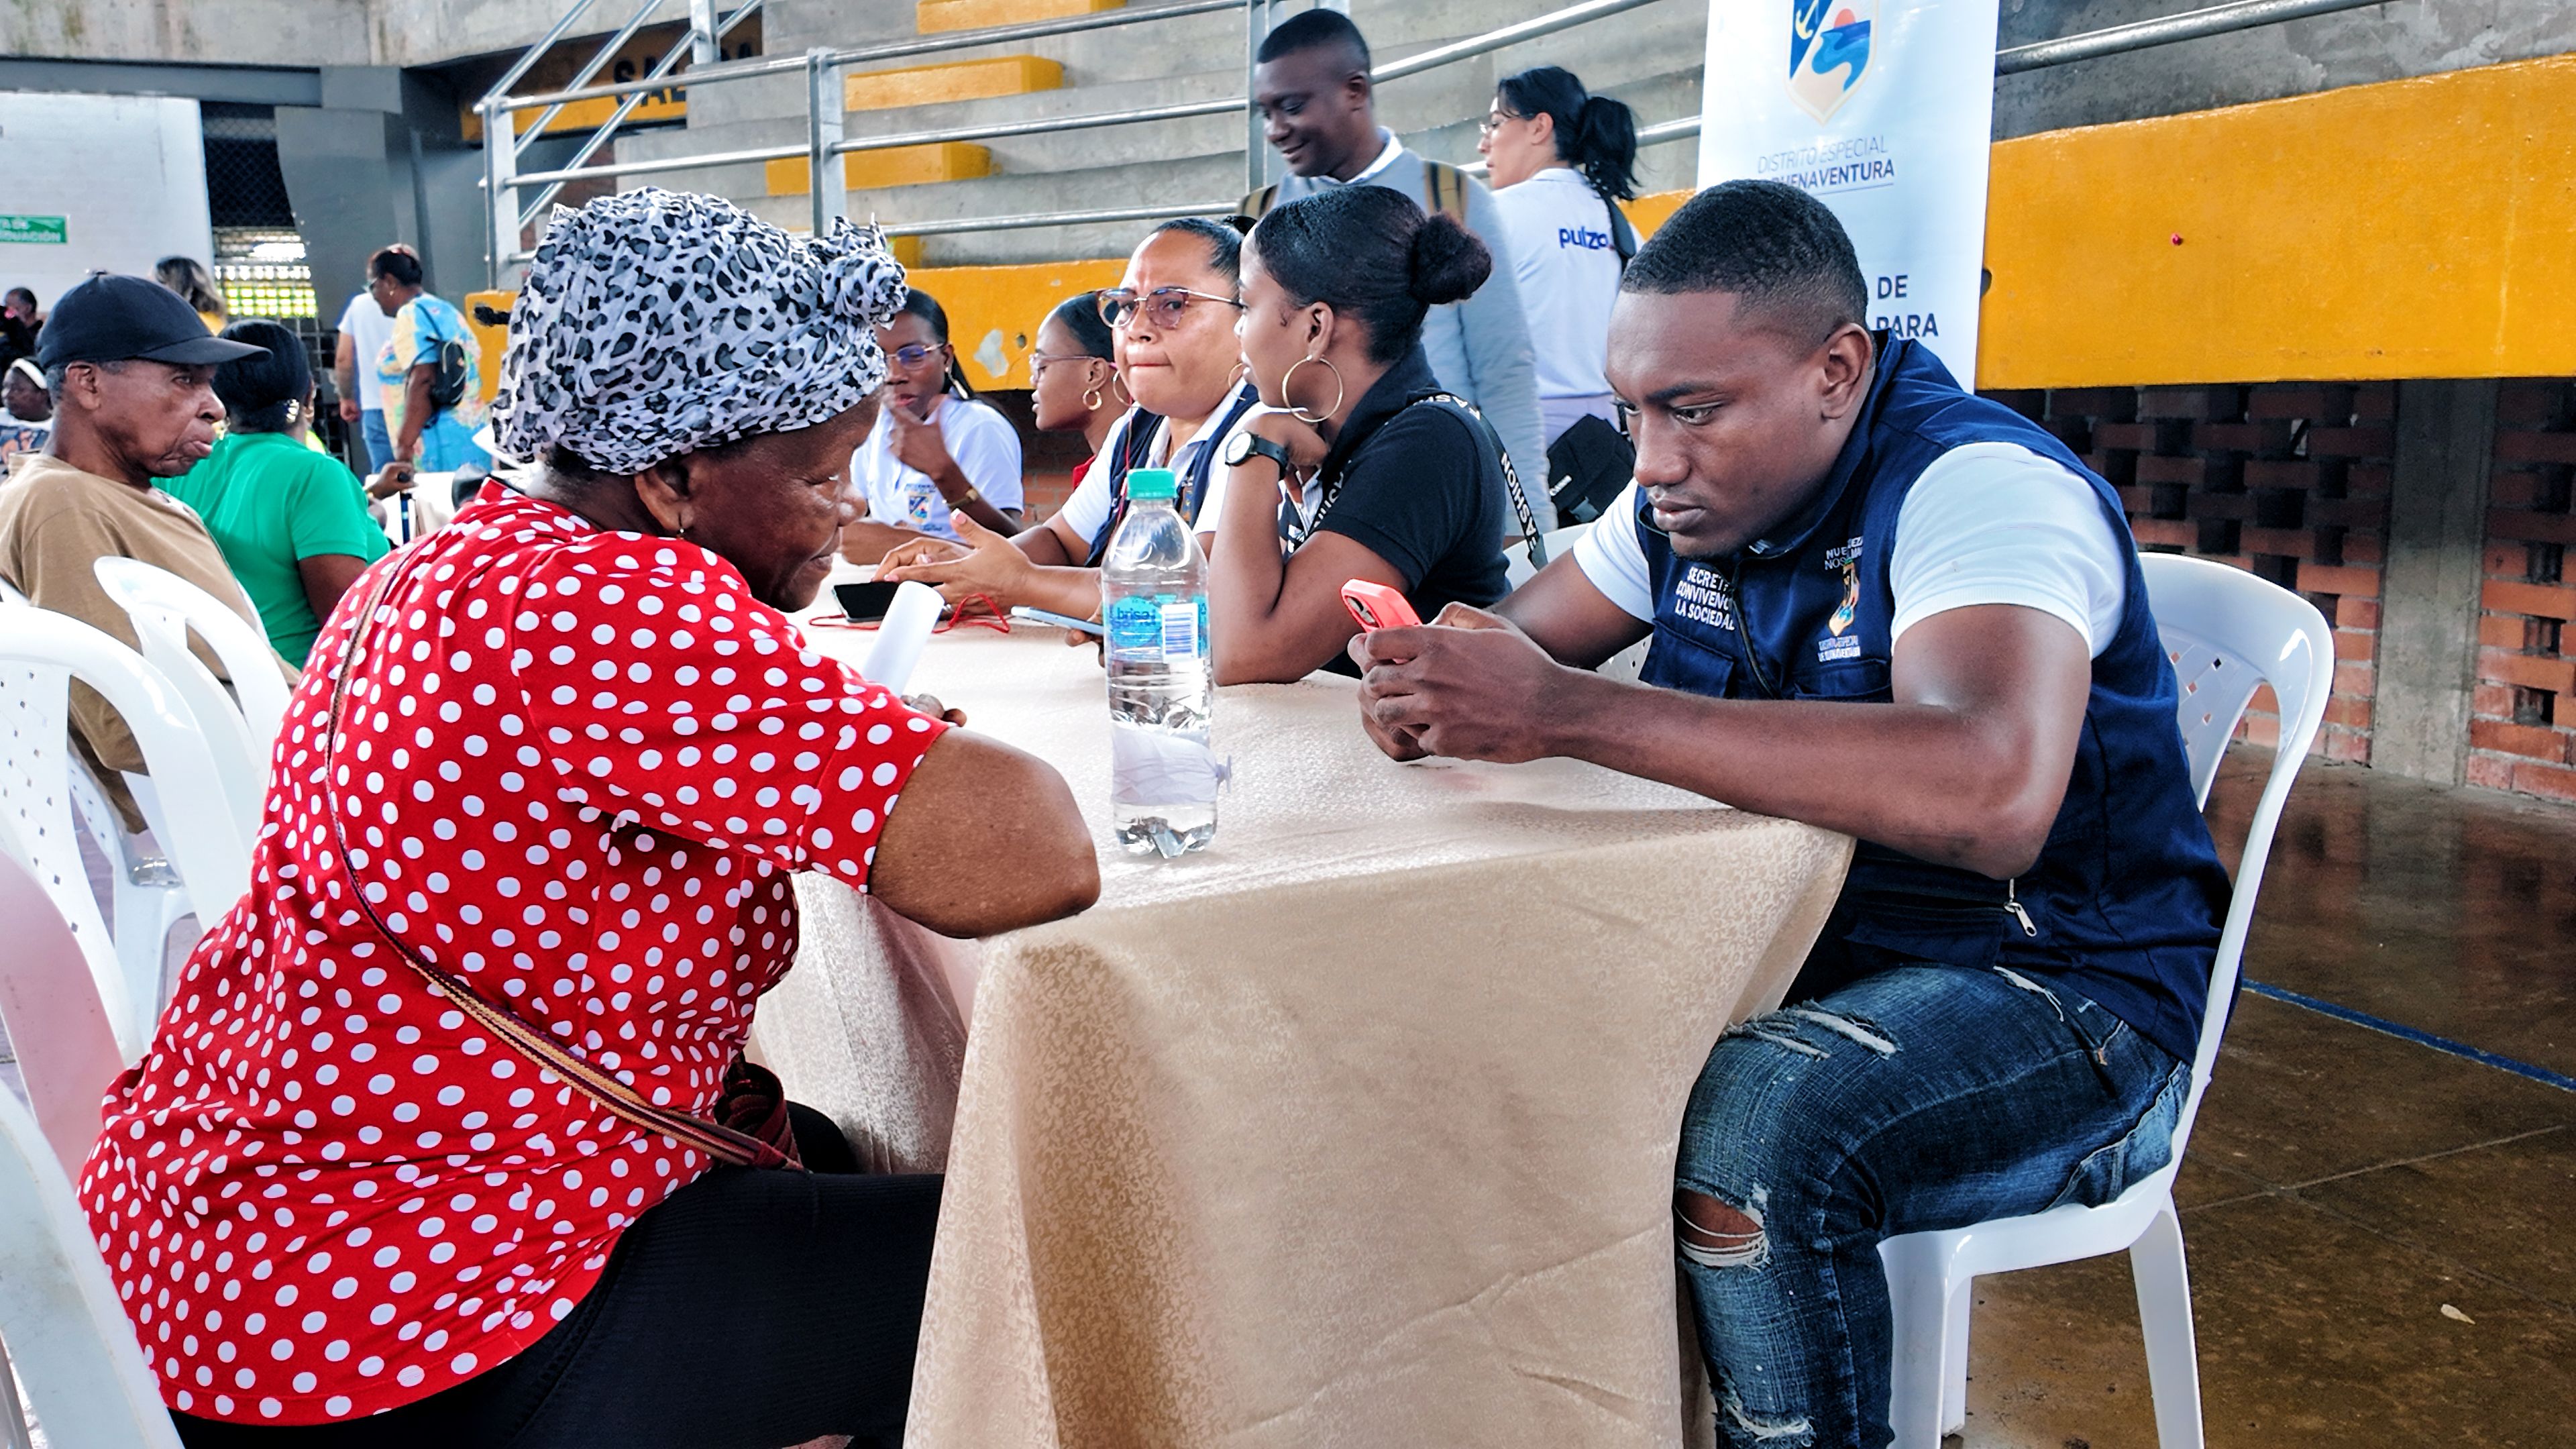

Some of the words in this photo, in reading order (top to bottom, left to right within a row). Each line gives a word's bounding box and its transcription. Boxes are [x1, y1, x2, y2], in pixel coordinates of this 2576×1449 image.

[1758, 147, 1817, 174] DISTRITO
[1819, 134, 1889, 163] ESPECIAL
[1772, 158, 1895, 189] ENAVENTURA
[1877, 274, 1908, 300] DE
[1876, 313, 1939, 337] PARA
[1674, 598, 1687, 618] LA
